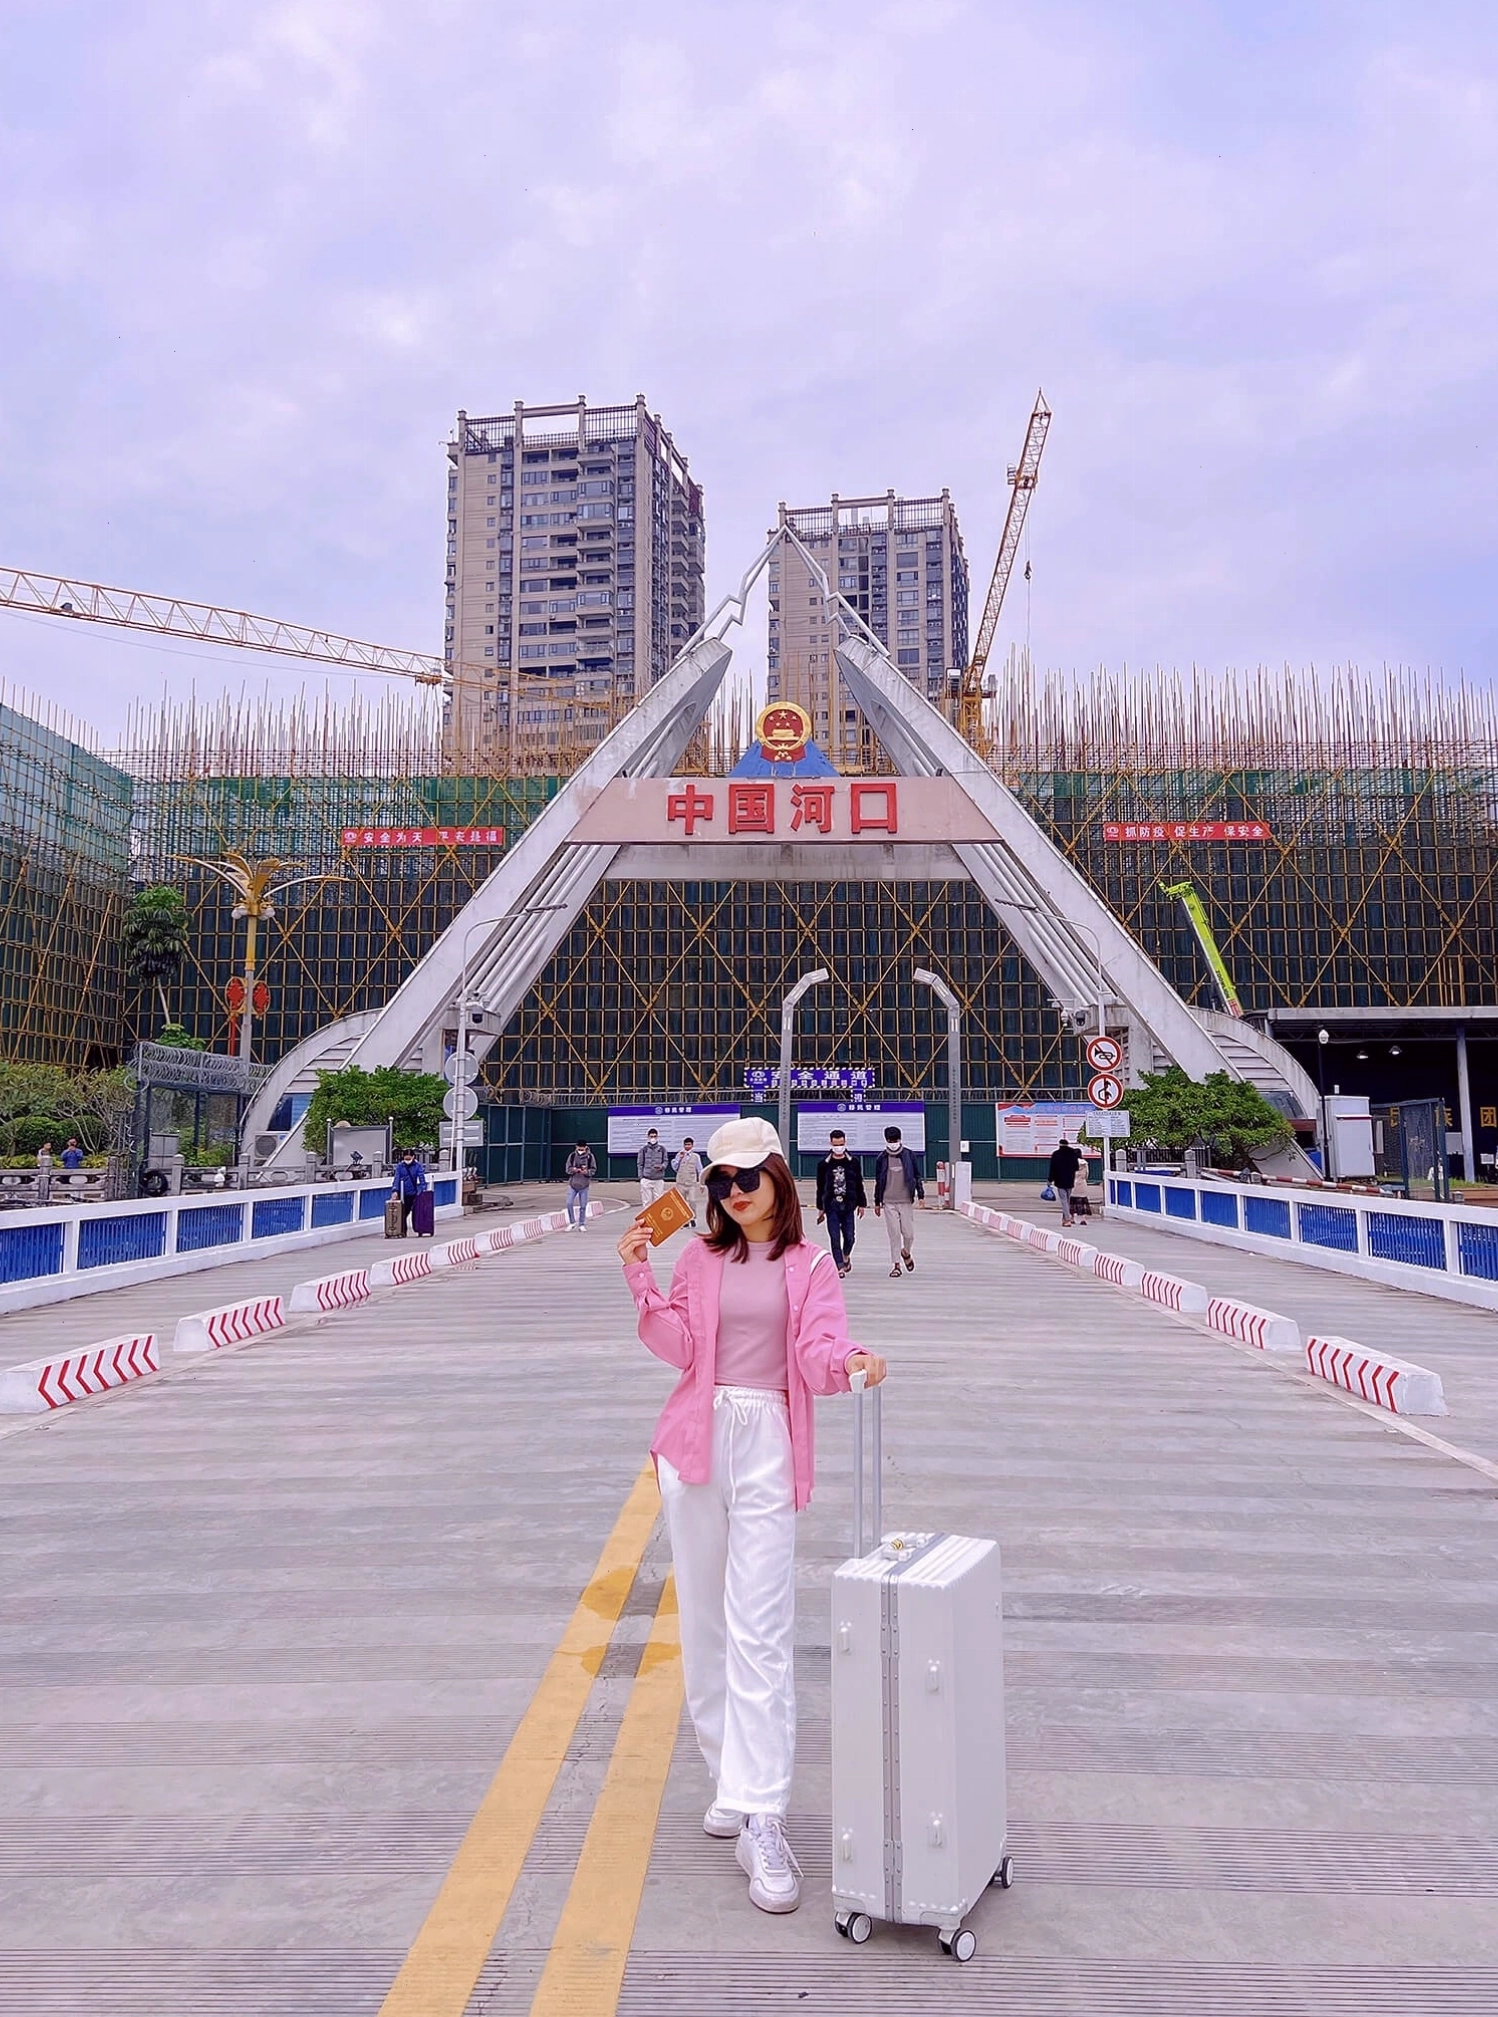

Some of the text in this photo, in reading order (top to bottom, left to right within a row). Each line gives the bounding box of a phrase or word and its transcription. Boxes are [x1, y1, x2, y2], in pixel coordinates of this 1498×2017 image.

[667, 783, 897, 835] 中国河口
[364, 831, 497, 843] 安全为天 平安是福
[1125, 826, 1264, 838] 抓防疫 促生产 保安全
